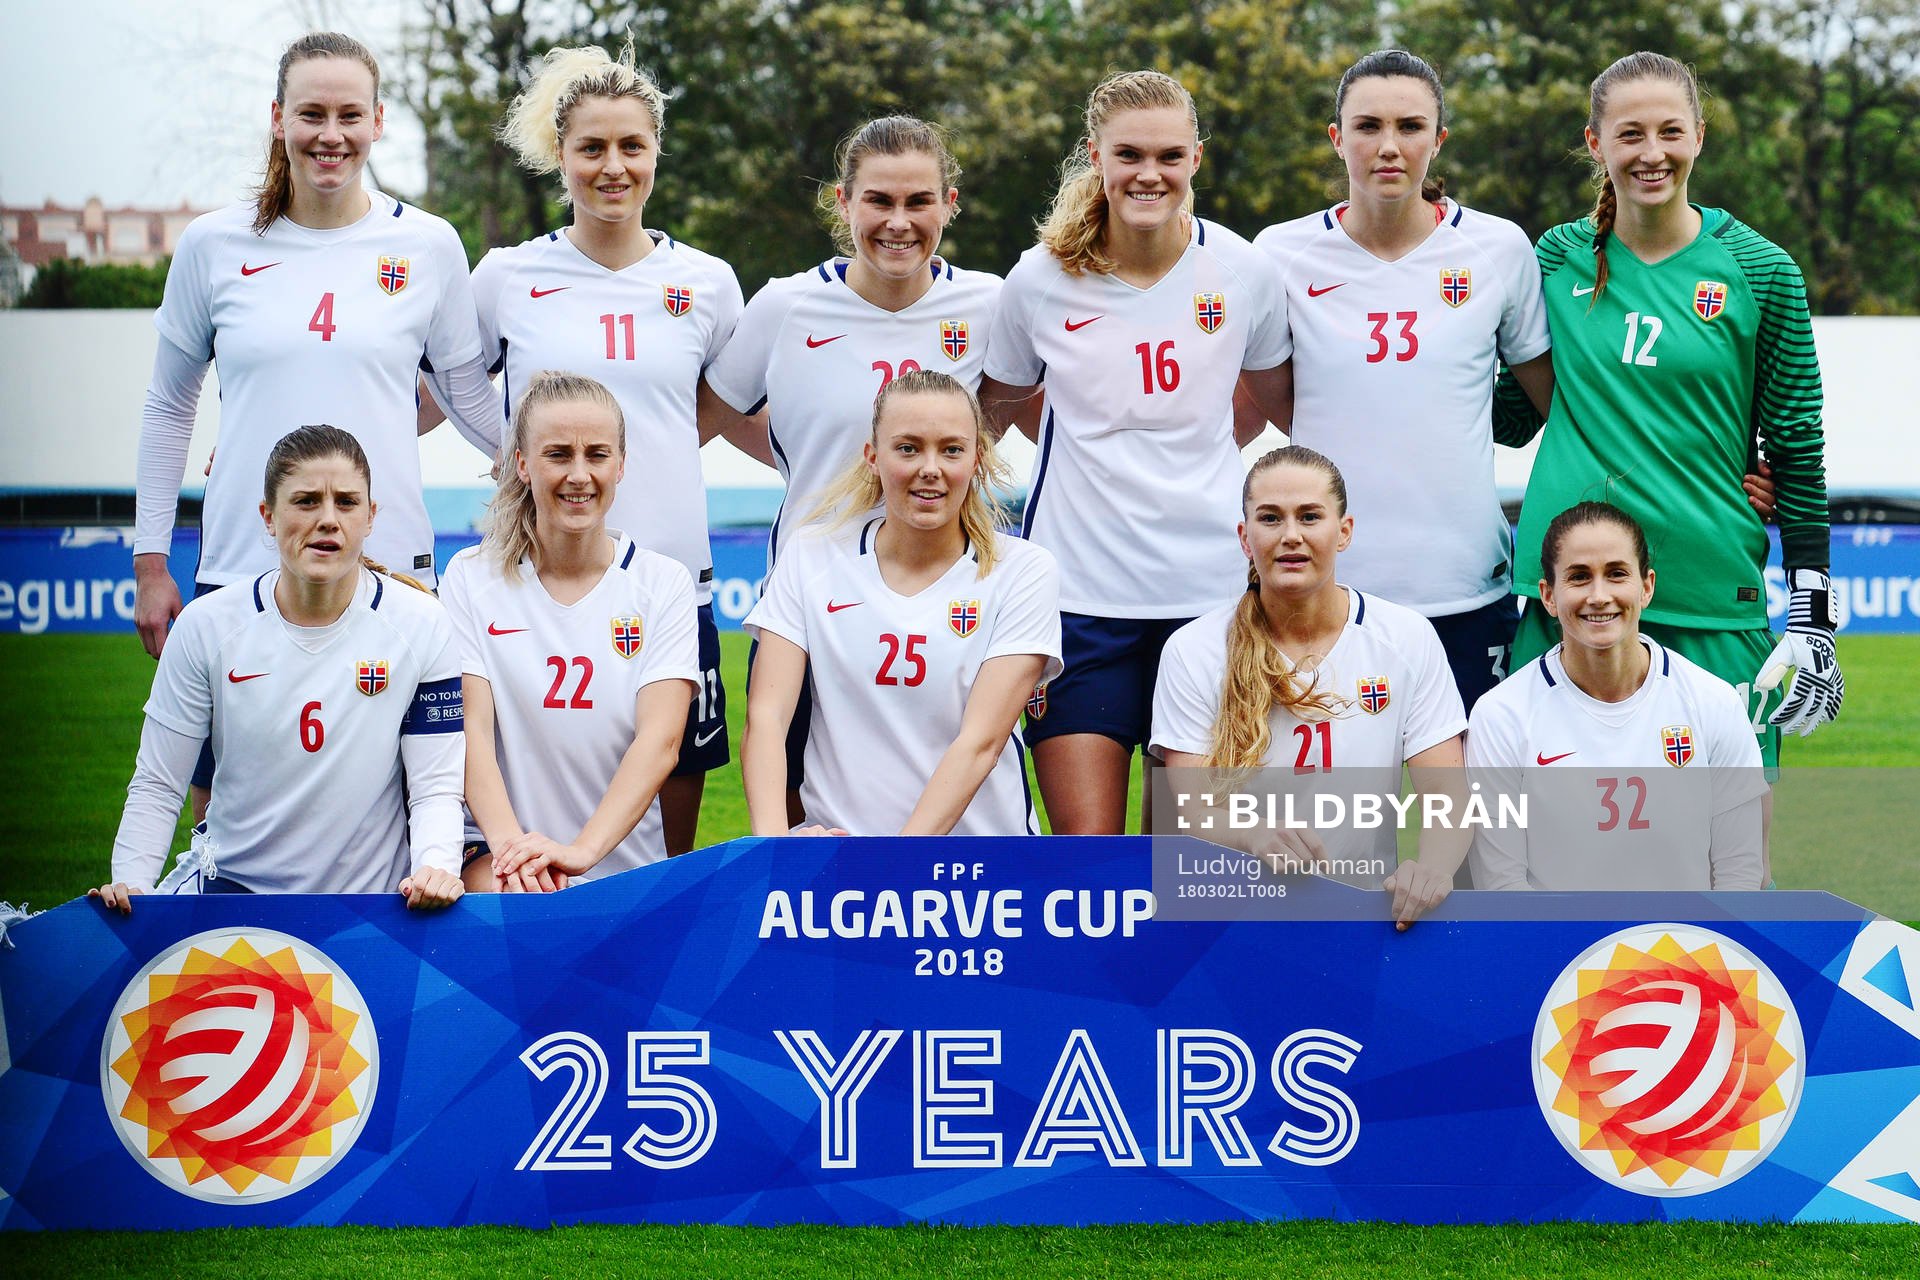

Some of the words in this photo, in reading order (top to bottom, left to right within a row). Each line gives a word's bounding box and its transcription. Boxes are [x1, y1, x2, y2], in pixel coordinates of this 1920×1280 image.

[309, 293, 336, 342] 4
[600, 313, 635, 361] 11
[1366, 310, 1419, 364] 33
[1621, 311, 1663, 367] 12
[1135, 339, 1181, 395] 16
[543, 655, 594, 710] 22
[875, 633, 927, 688] 25
[420, 693, 437, 701] NO
[438, 691, 451, 700] TO
[299, 700, 325, 753] 6
[1292, 720, 1333, 775] 21
[1596, 775, 1650, 832] 32
[933, 862, 985, 881] FPF
[758, 889, 1023, 939] ALGARVE
[1043, 889, 1158, 938] CUP
[914, 948, 1004, 976] 2018
[515, 1030, 718, 1171] 25
[773, 1028, 1364, 1169] YEARS
